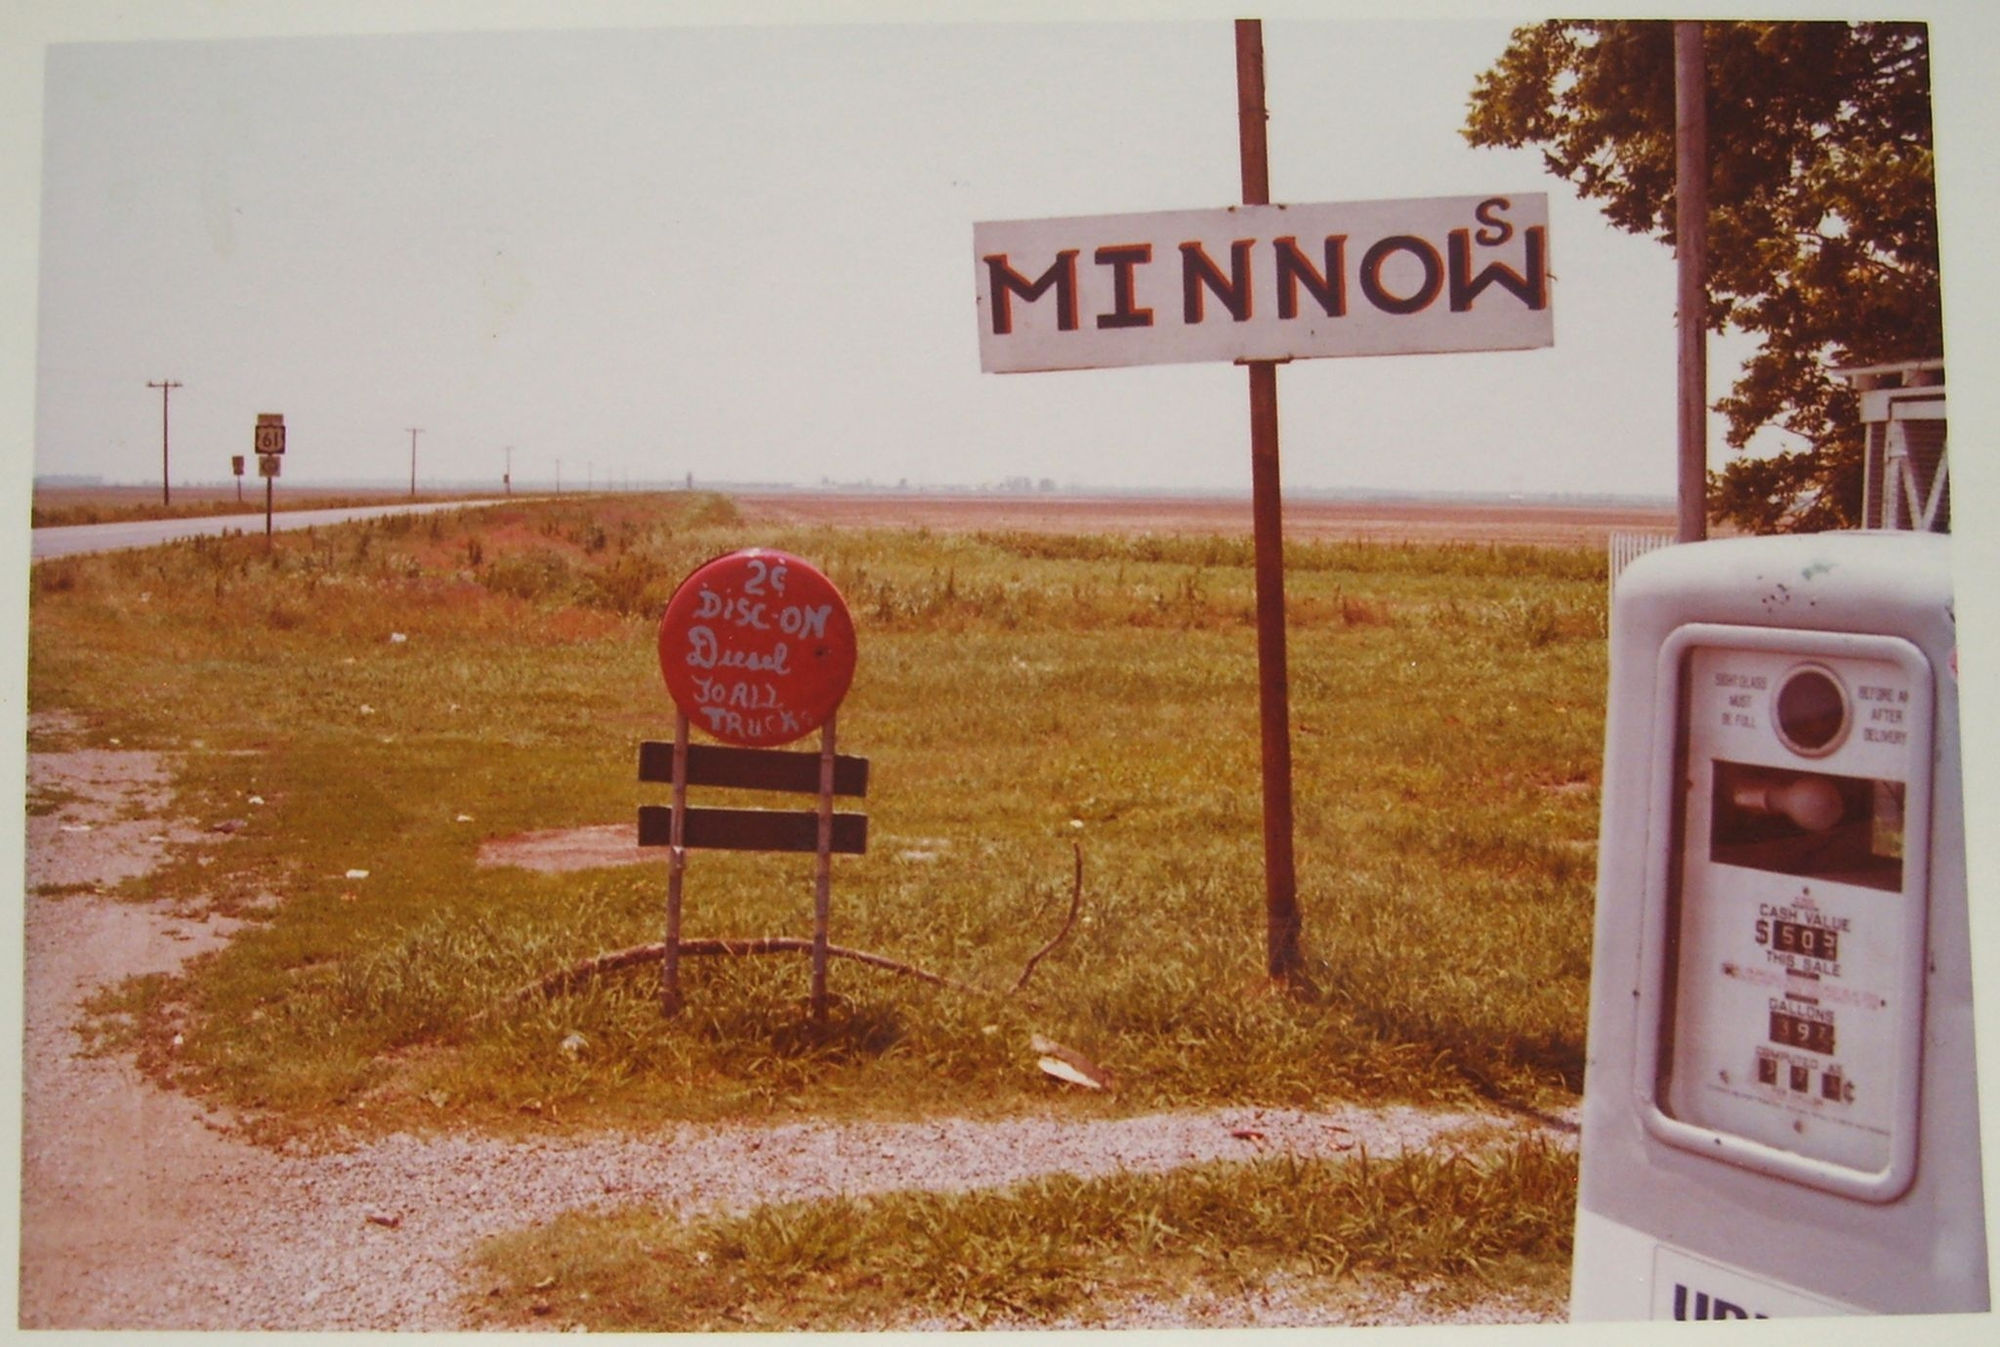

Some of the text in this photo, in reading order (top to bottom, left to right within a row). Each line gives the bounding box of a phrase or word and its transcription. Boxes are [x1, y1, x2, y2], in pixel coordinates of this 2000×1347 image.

[262, 431, 279, 448] 61
[686, 625, 791, 675] Diesel
[1760, 903, 1798, 920] CASH
[1805, 912, 1851, 933] VALUE
[1766, 950, 1795, 968] THIS
[1803, 957, 1841, 977] SALE
[1769, 998, 1835, 1024] GALLONS
